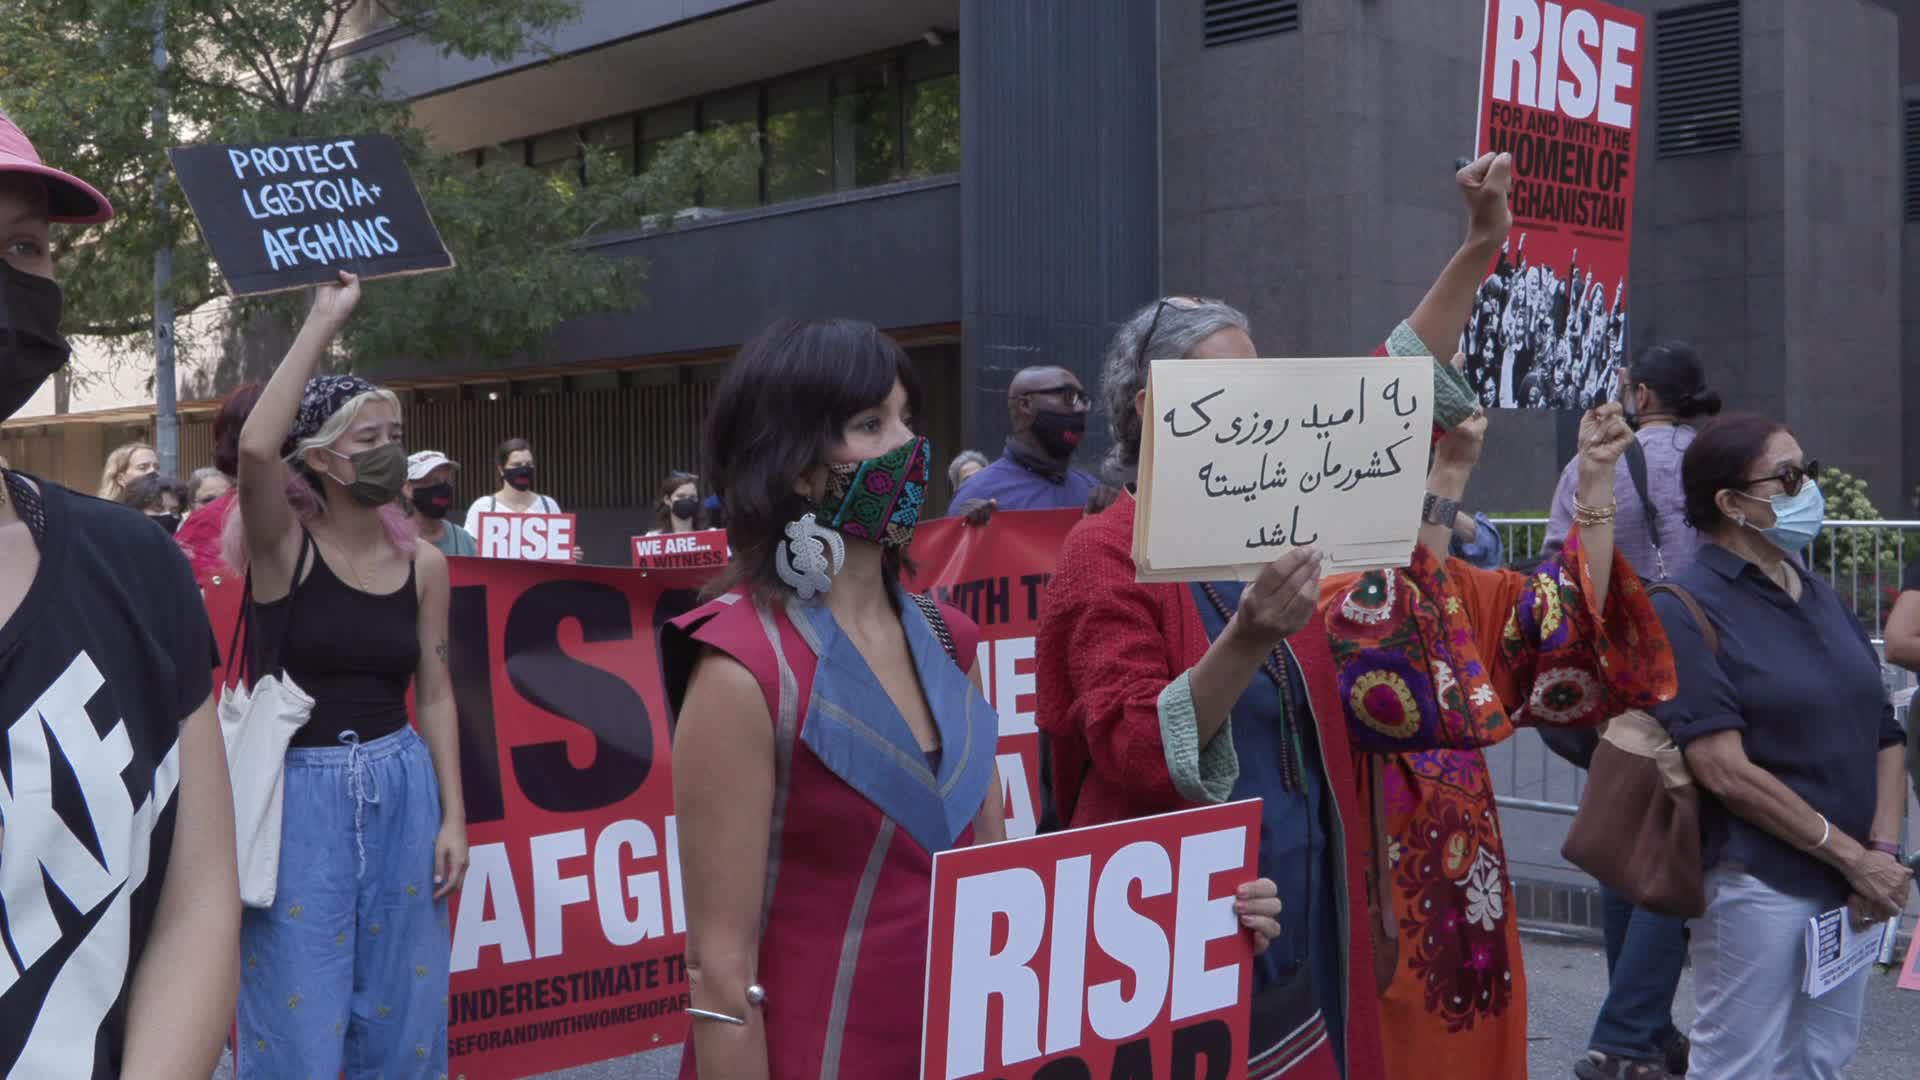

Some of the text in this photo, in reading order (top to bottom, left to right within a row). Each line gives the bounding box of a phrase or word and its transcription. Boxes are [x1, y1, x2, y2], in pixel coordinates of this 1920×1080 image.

[1492, 0, 1636, 128] RISE
[1490, 102, 1631, 151] FOR AND WITH THE
[228, 140, 358, 179] PROTECT
[1489, 126, 1629, 193] WOMEN OF
[243, 178, 382, 219] LGBTQIA+
[1507, 178, 1626, 231] GHANISTAN
[262, 216, 399, 271] AFGHANS
[1163, 377, 1417, 445] به امید روزی که
[1198, 435, 1413, 502] کشورمان شایسته
[482, 516, 571, 560] RISE
[636, 536, 711, 556] WE ARE...
[654, 550, 723, 568] WITNESS
[1021, 573, 1050, 620] T
[946, 826, 1247, 1080] RISE
